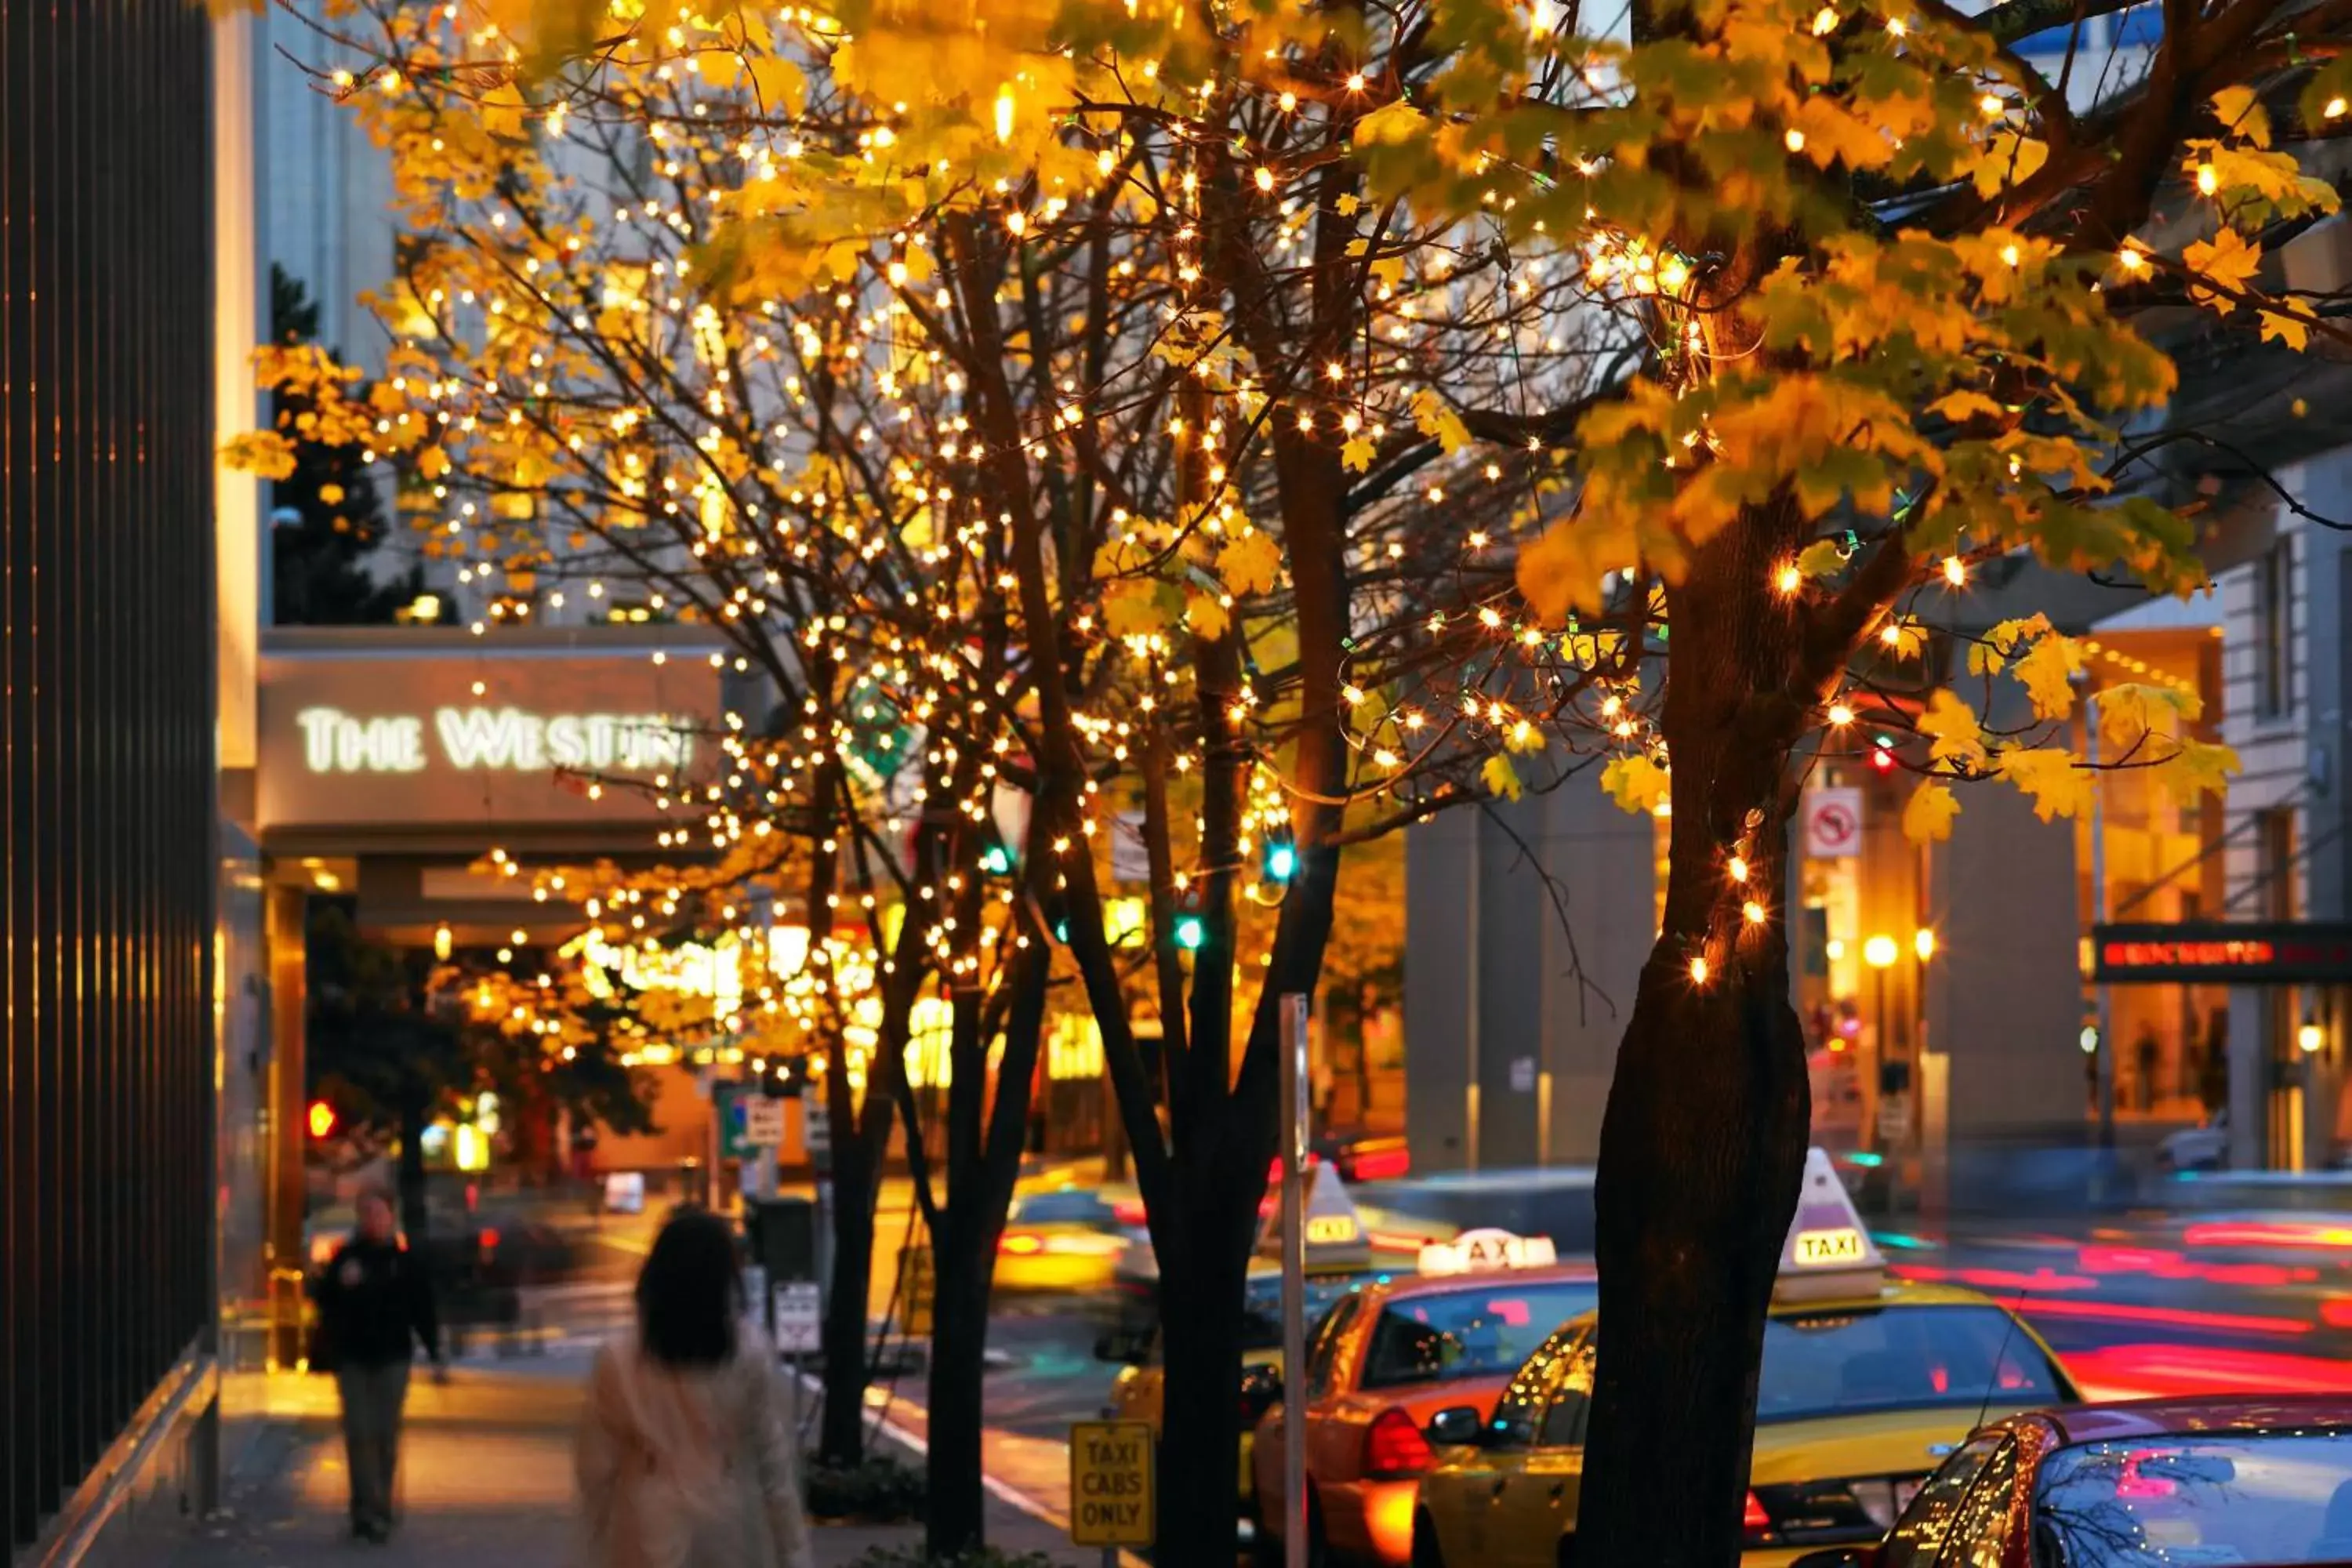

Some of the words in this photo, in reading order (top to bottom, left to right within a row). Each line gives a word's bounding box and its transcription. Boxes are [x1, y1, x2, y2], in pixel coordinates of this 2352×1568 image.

[1801, 1236, 1857, 1257] TAXI
[1087, 1441, 1139, 1465] TAXI
[1082, 1472, 1142, 1496] CABS
[1082, 1502, 1140, 1526] ONLY
